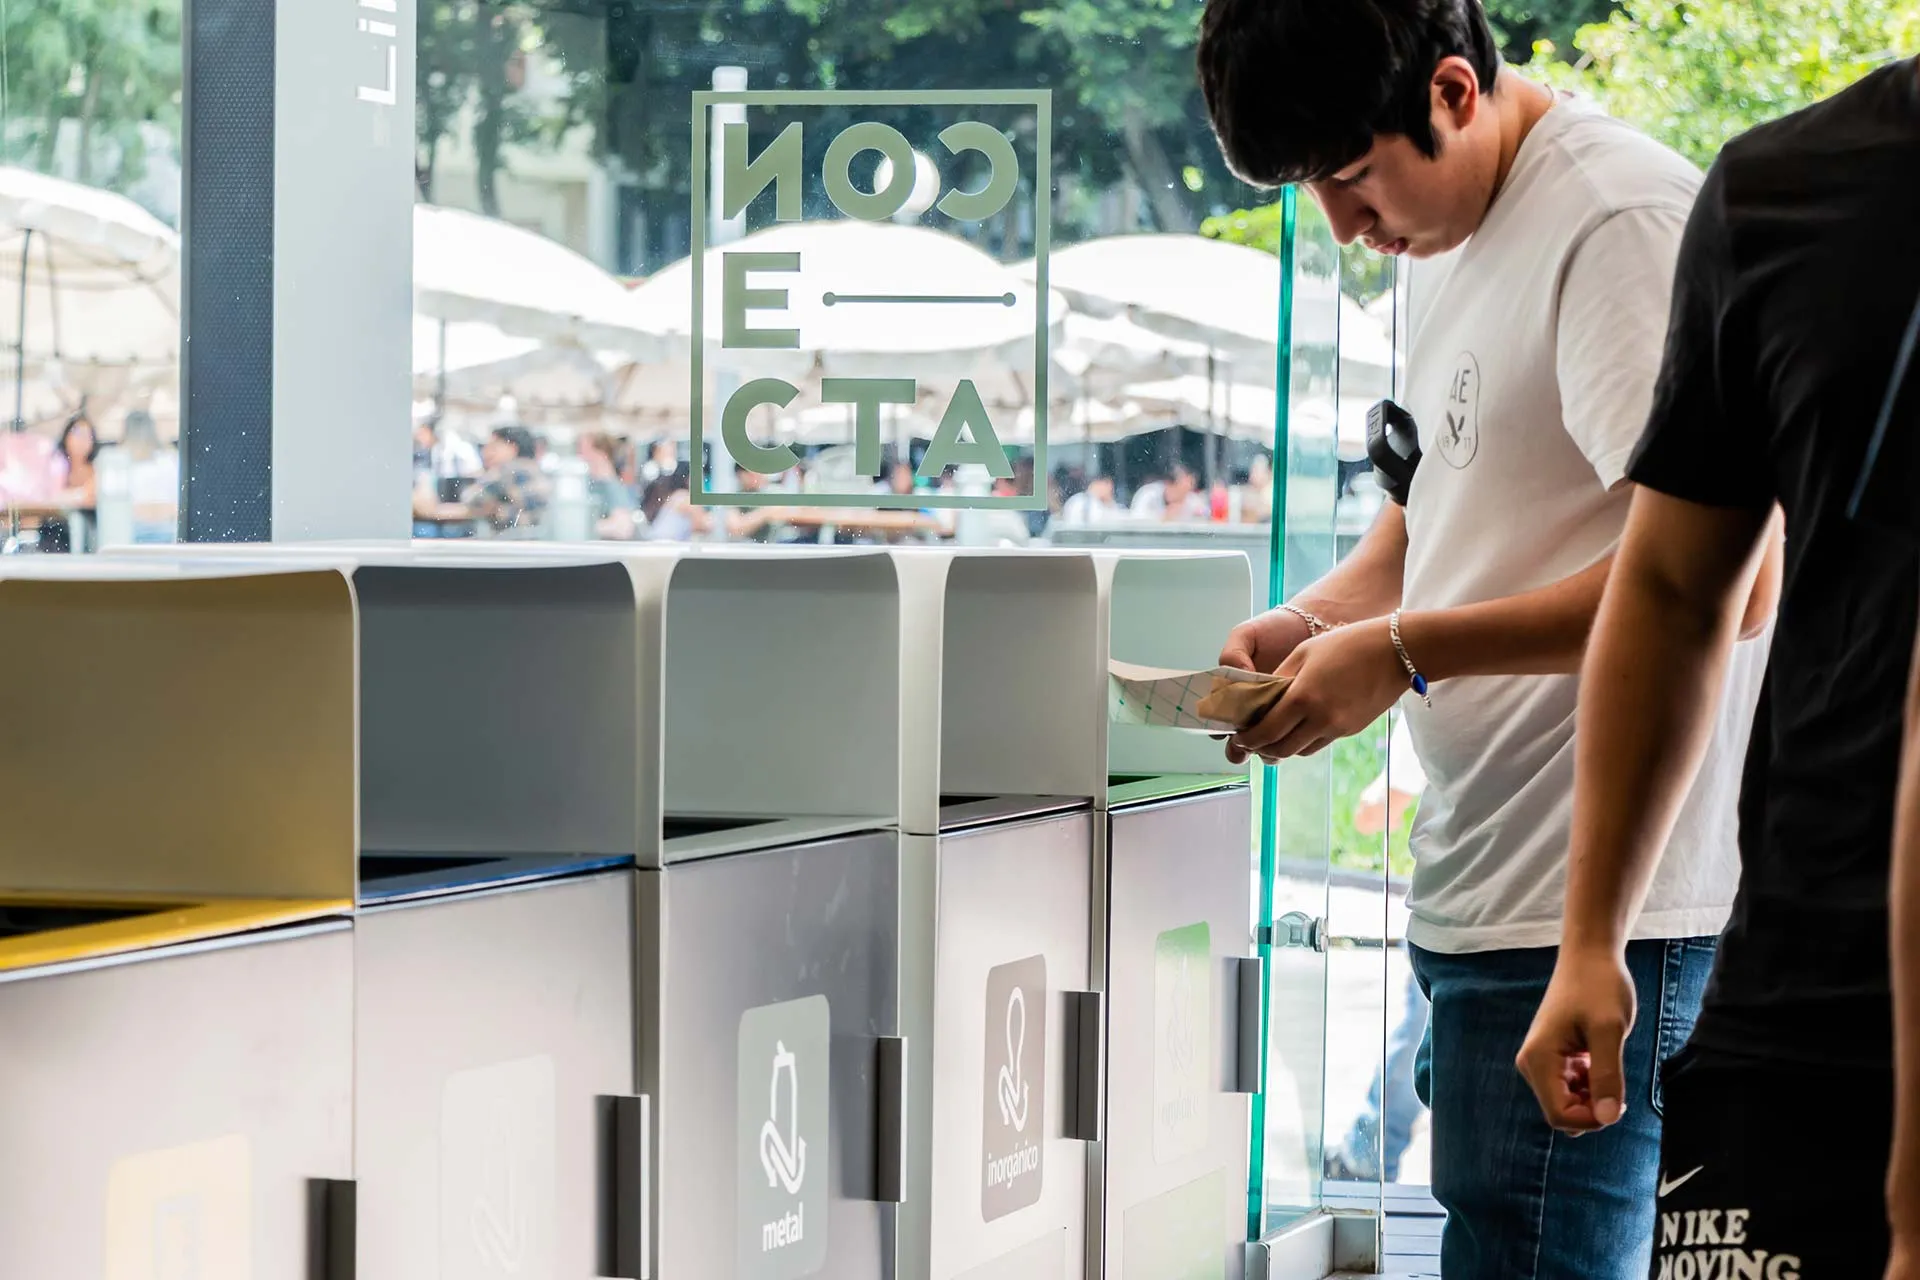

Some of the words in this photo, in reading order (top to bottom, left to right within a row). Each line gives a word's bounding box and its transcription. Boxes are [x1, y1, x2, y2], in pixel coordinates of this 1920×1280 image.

[357, 0, 397, 105] Li
[722, 252, 800, 349] E
[721, 377, 1015, 479] CTA
[987, 1140, 1038, 1189] inorgánico
[762, 1201, 804, 1252] metal
[1660, 1208, 1750, 1248] NIKE
[1656, 1248, 1801, 1280] MOVING
